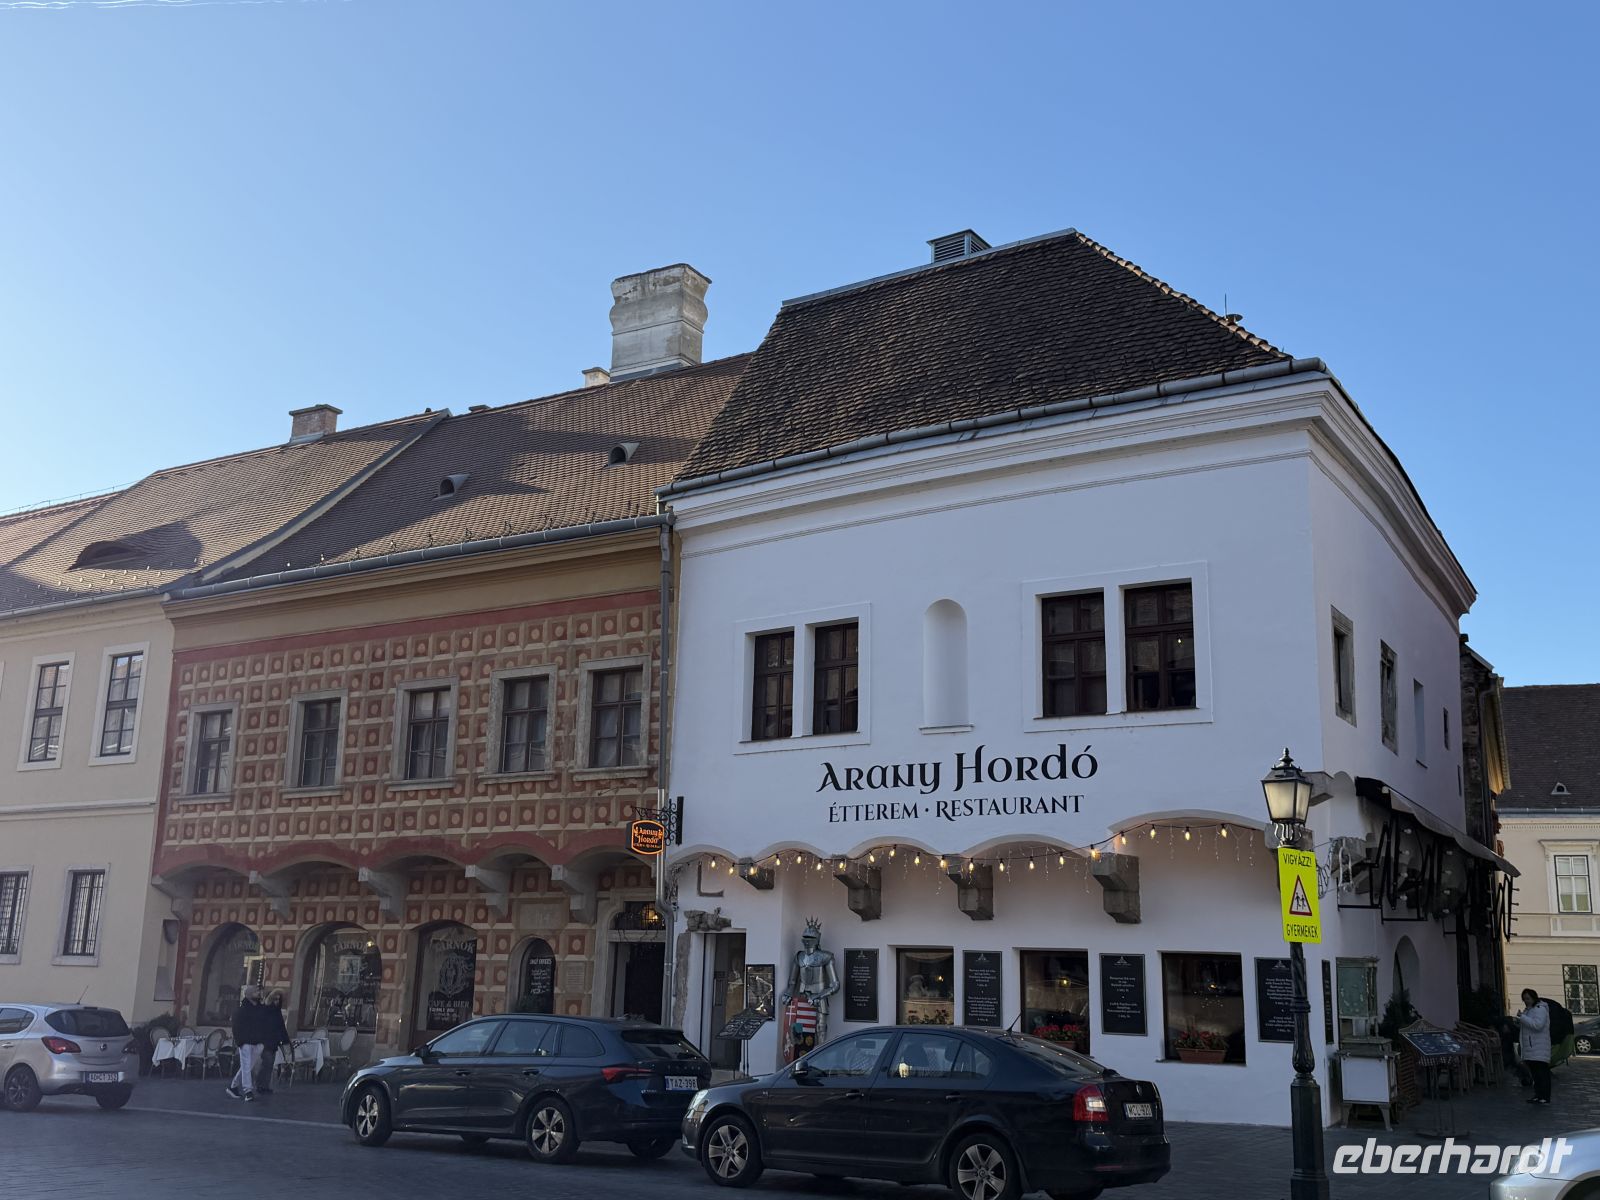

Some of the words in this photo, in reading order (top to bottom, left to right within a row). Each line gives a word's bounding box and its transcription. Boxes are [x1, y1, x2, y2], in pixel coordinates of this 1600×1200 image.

[953, 743, 1098, 792] Hordó
[828, 802, 919, 823] ÉTTEREM
[936, 794, 1085, 822] RESTAURANT
[1283, 852, 1313, 868] VIGYÁZZ!
[1286, 923, 1319, 939] GYERMEKEK
